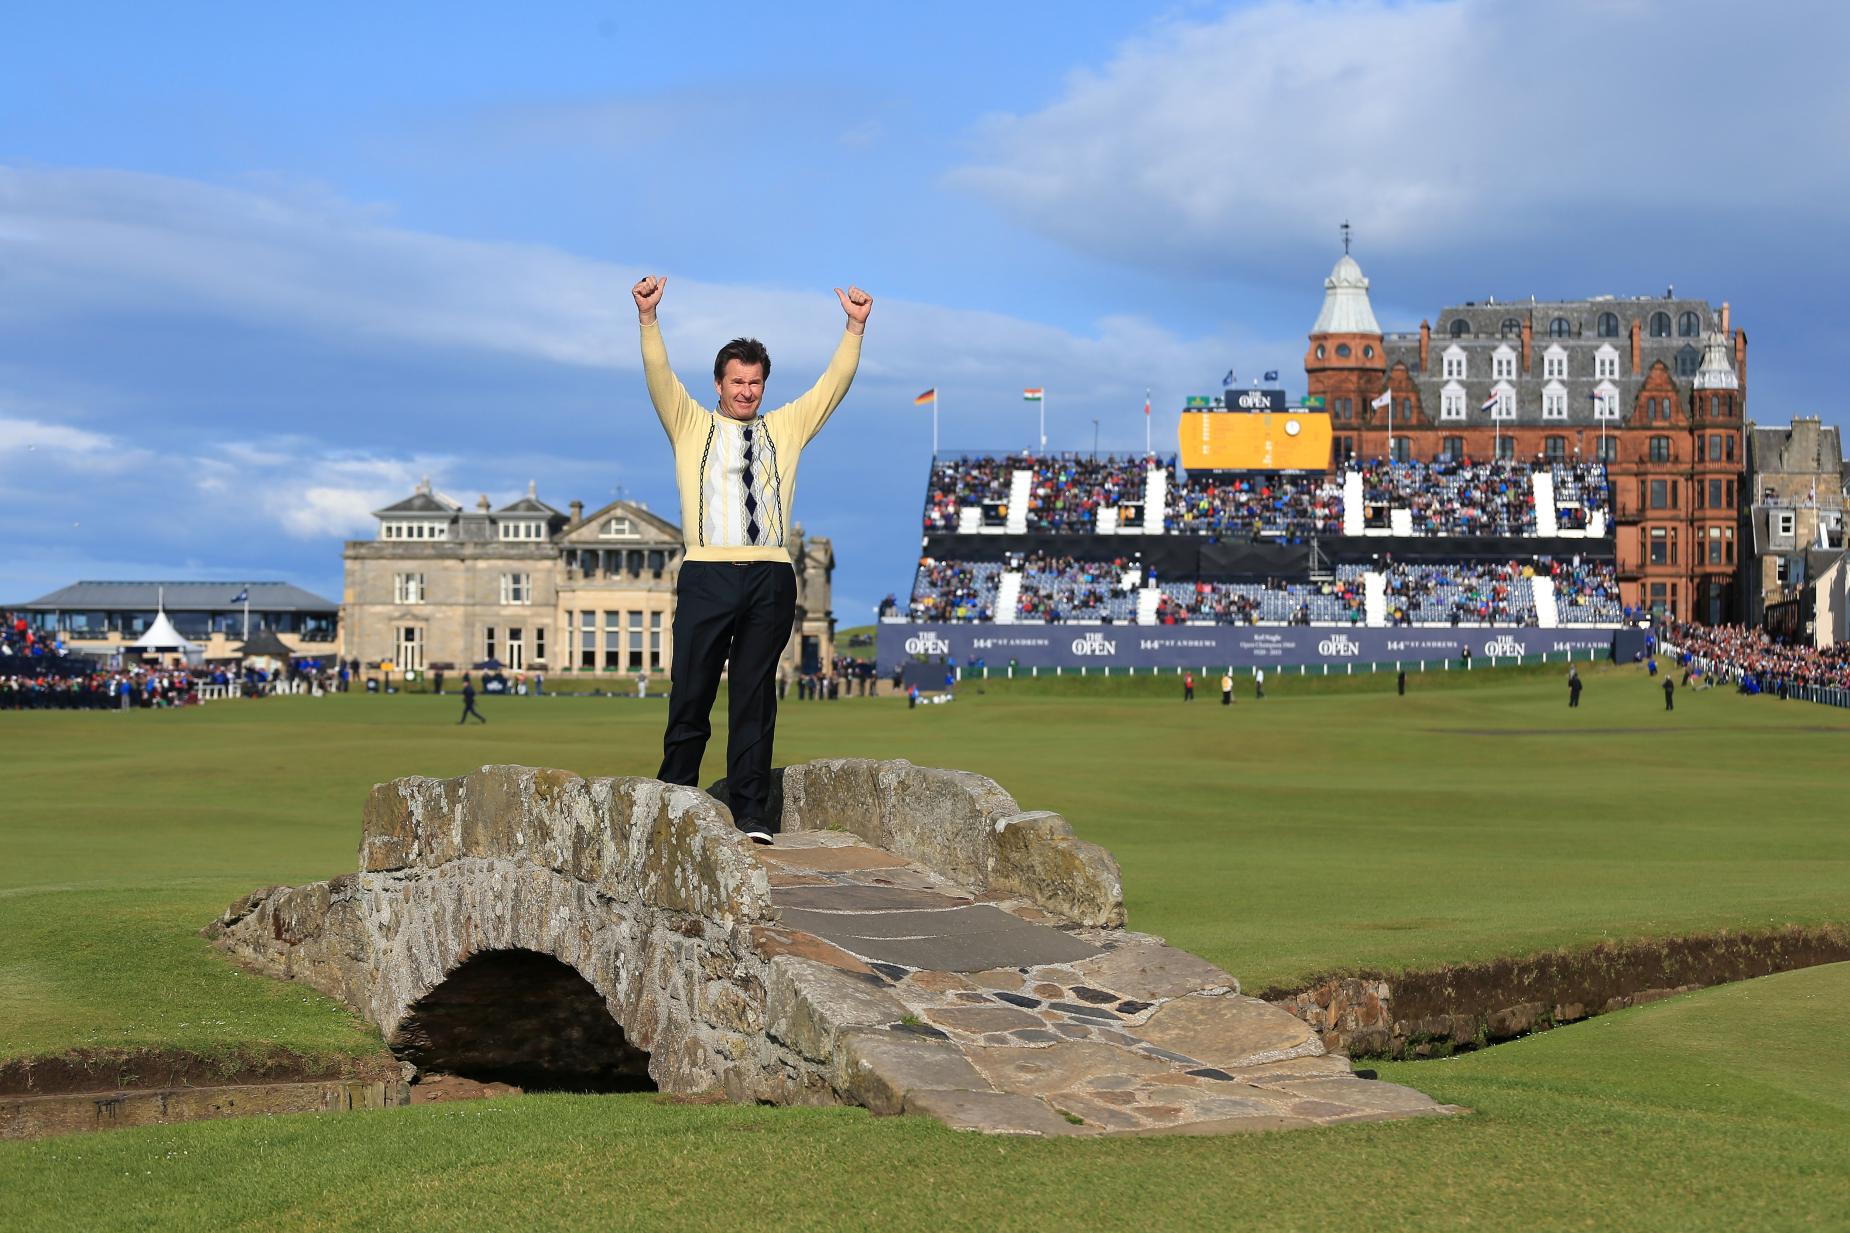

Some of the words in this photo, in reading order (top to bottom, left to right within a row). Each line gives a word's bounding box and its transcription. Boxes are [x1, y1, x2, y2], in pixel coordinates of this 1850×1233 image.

[1238, 396, 1271, 408] OPEN
[918, 631, 937, 641] THE
[1085, 632, 1104, 642] THE
[1331, 634, 1349, 644] THE
[1497, 635, 1514, 644] THE
[905, 637, 949, 654] OPEN
[1072, 638, 1116, 656] OPEN
[1318, 640, 1359, 656] OPEN
[1485, 640, 1525, 657] OPEN
